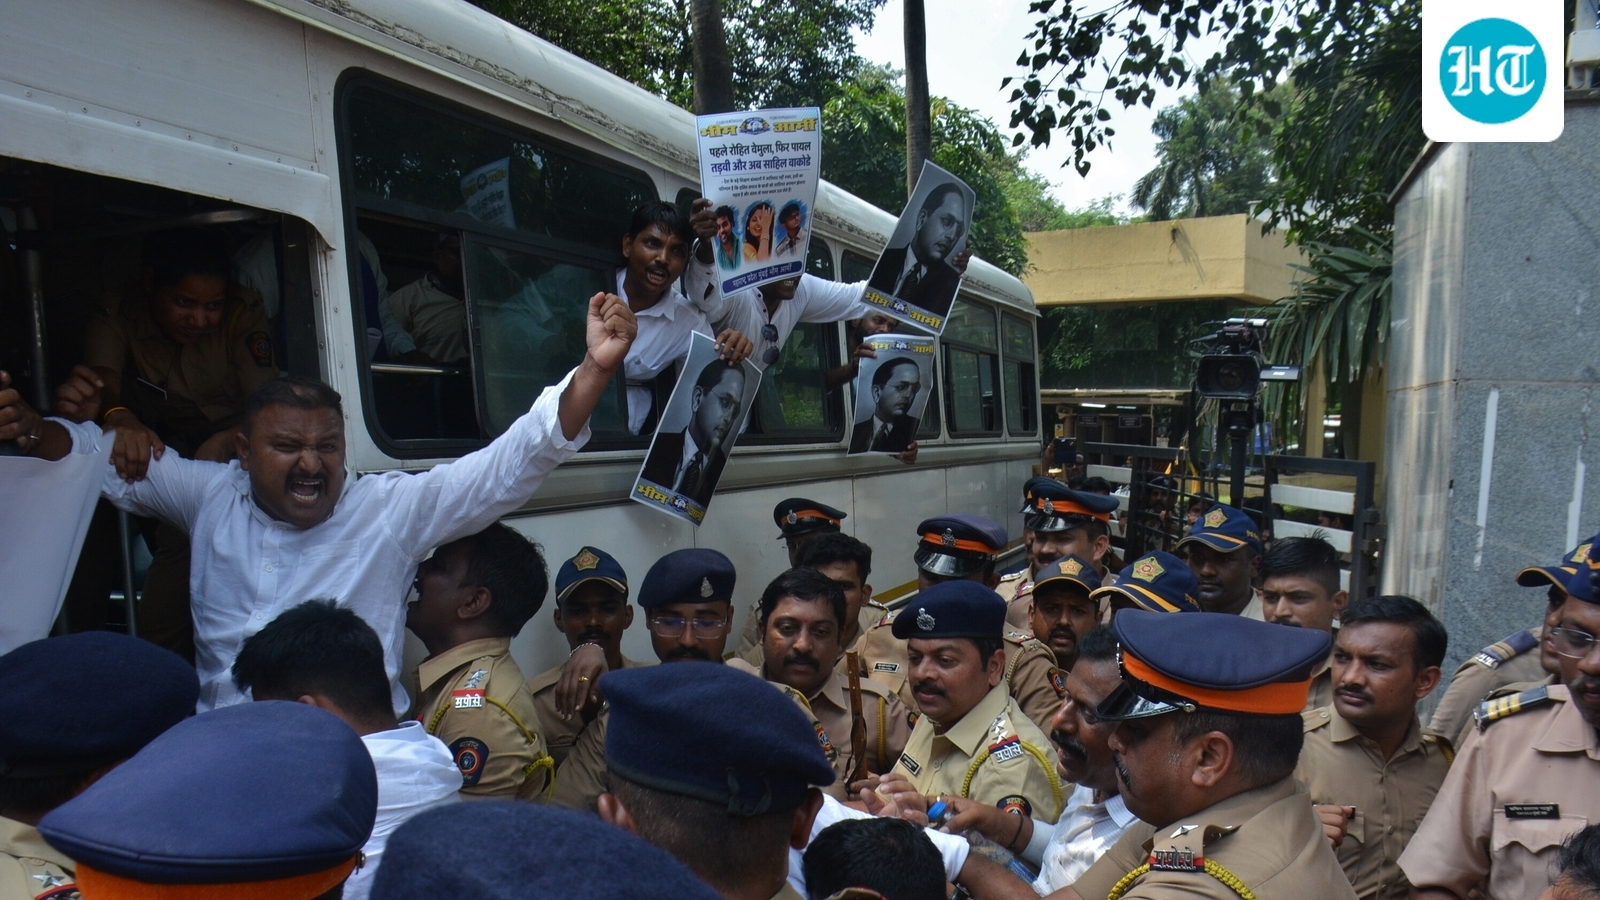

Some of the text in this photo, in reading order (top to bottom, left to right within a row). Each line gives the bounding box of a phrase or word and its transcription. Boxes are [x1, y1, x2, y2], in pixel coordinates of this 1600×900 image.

[700, 125, 738, 138] भीम
[709, 141, 811, 158] पहले रोहित वेमुला, फिर पायल
[711, 154, 811, 174] तड़वी और अब साहिल वाकोडे
[769, 266, 778, 275] भीम
[865, 292, 889, 308] भीम
[638, 485, 668, 505] भीम
[994, 742, 1024, 763] मपोसे
